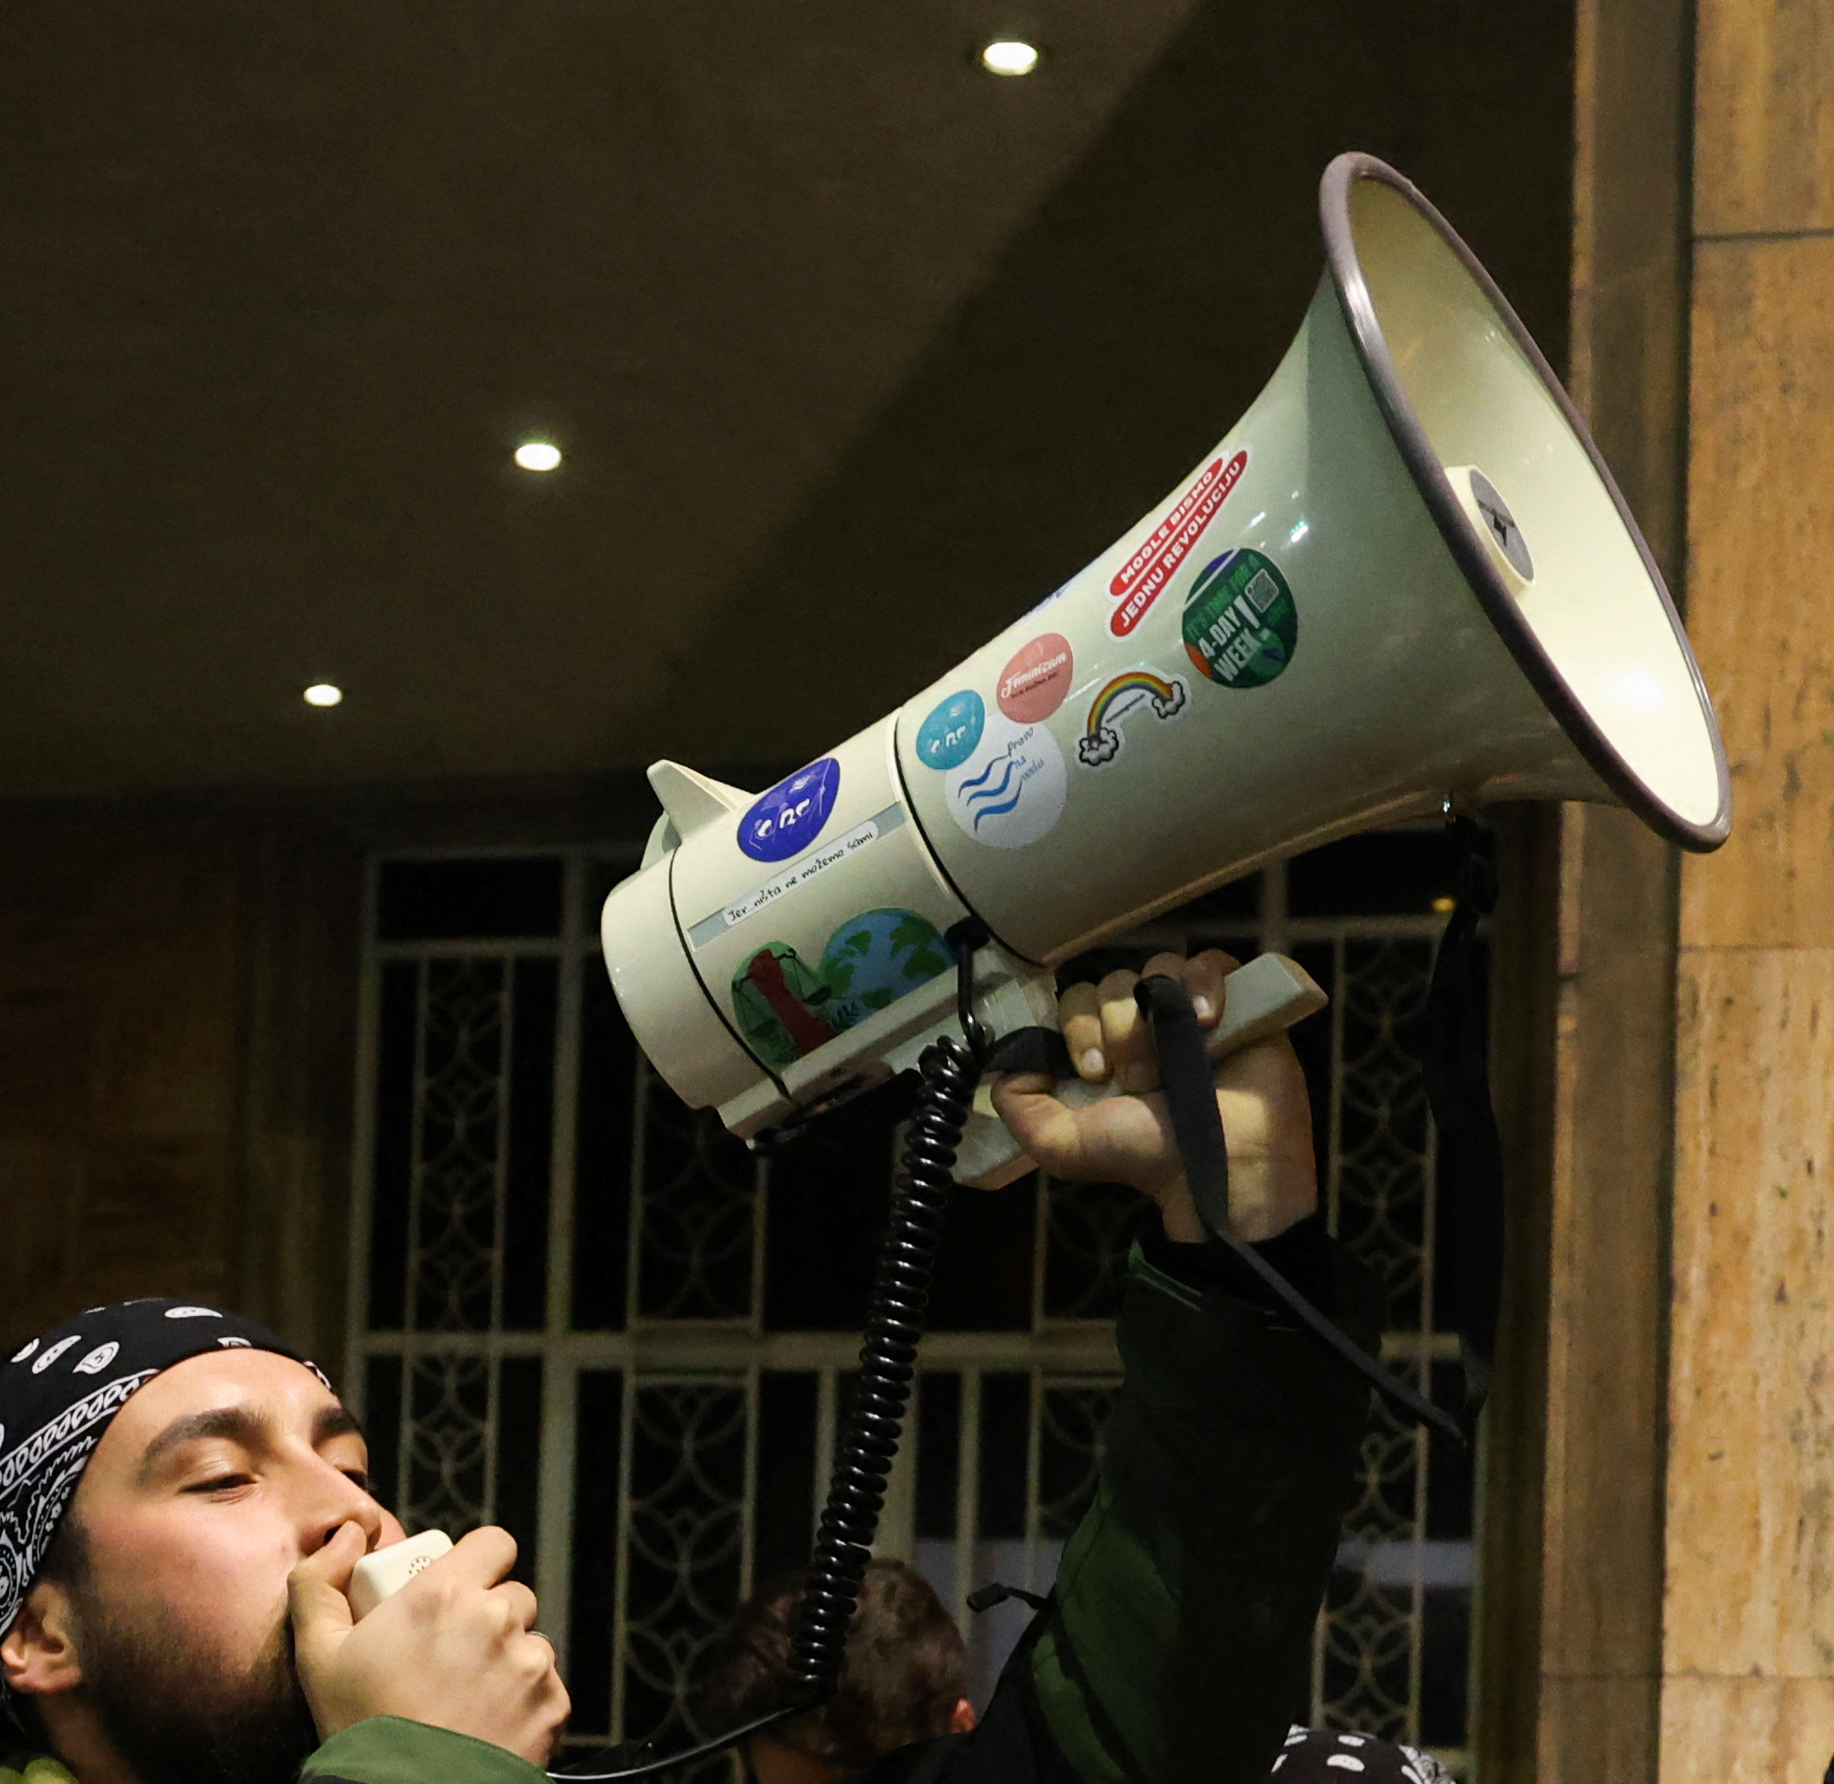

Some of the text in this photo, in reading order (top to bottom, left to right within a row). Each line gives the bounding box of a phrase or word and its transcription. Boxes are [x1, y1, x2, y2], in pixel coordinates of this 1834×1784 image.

[1169, 471, 1214, 527] BISMO
[1119, 566, 1166, 628] JEDNU
[1161, 460, 1241, 569] REVOLUCIJU
[1198, 606, 1242, 659] 4-DAY
[785, 876, 798, 889] ne
